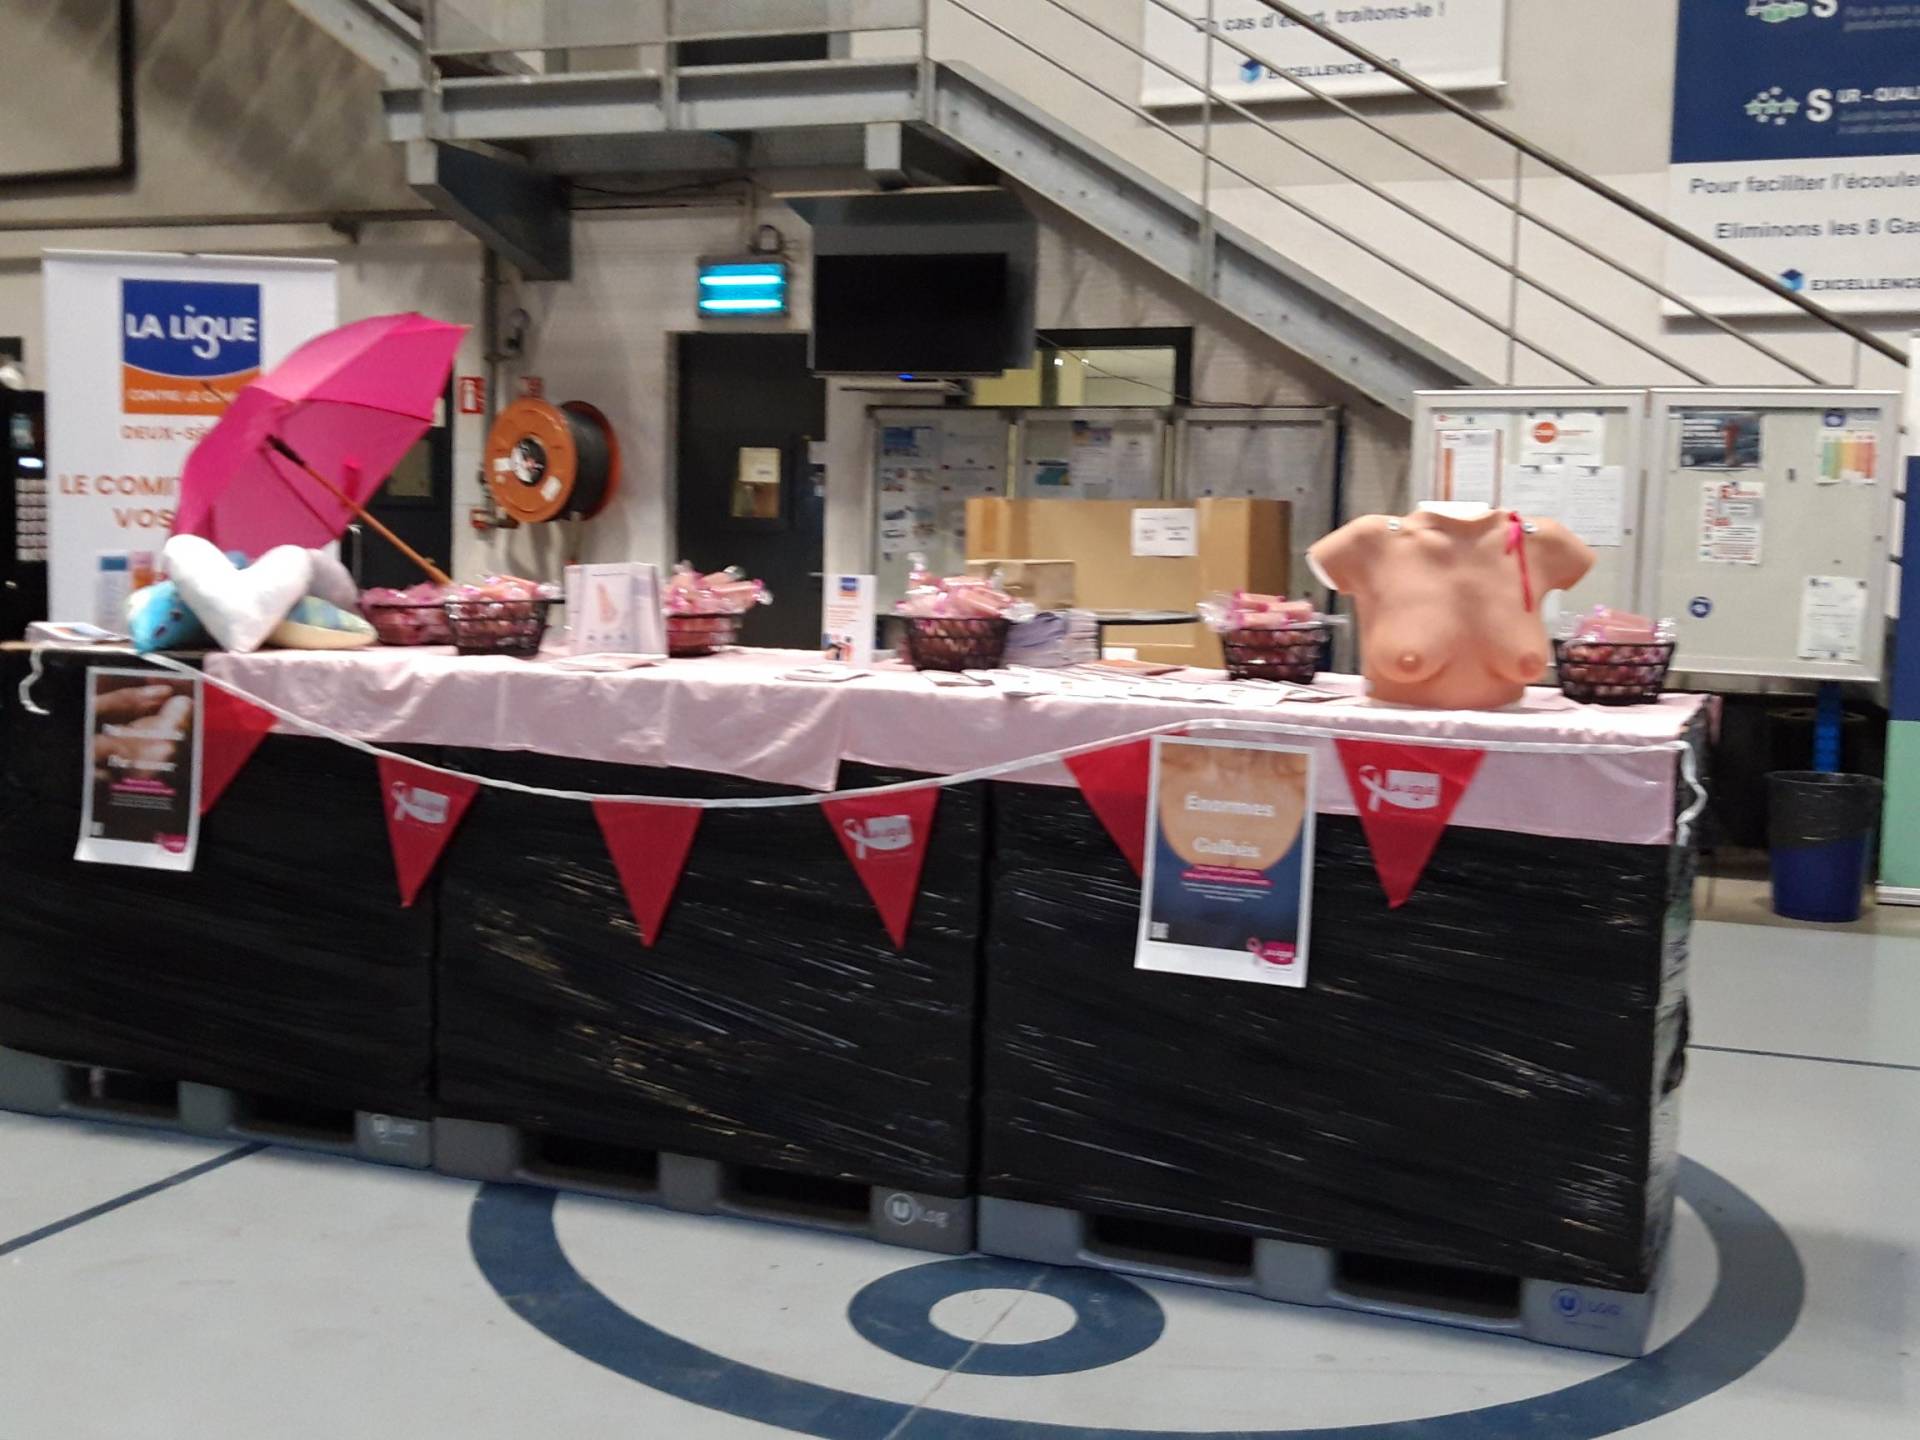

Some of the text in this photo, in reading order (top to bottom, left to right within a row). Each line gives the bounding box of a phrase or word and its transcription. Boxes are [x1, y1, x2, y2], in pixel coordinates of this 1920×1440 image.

[1224, 17, 1256, 31] cas
[1690, 171, 1920, 195] Pour faciliter l'écoule
[1828, 219, 1860, 236] les
[1866, 218, 1880, 235] 8
[126, 313, 165, 339] LA
[59, 475, 89, 494] LE
